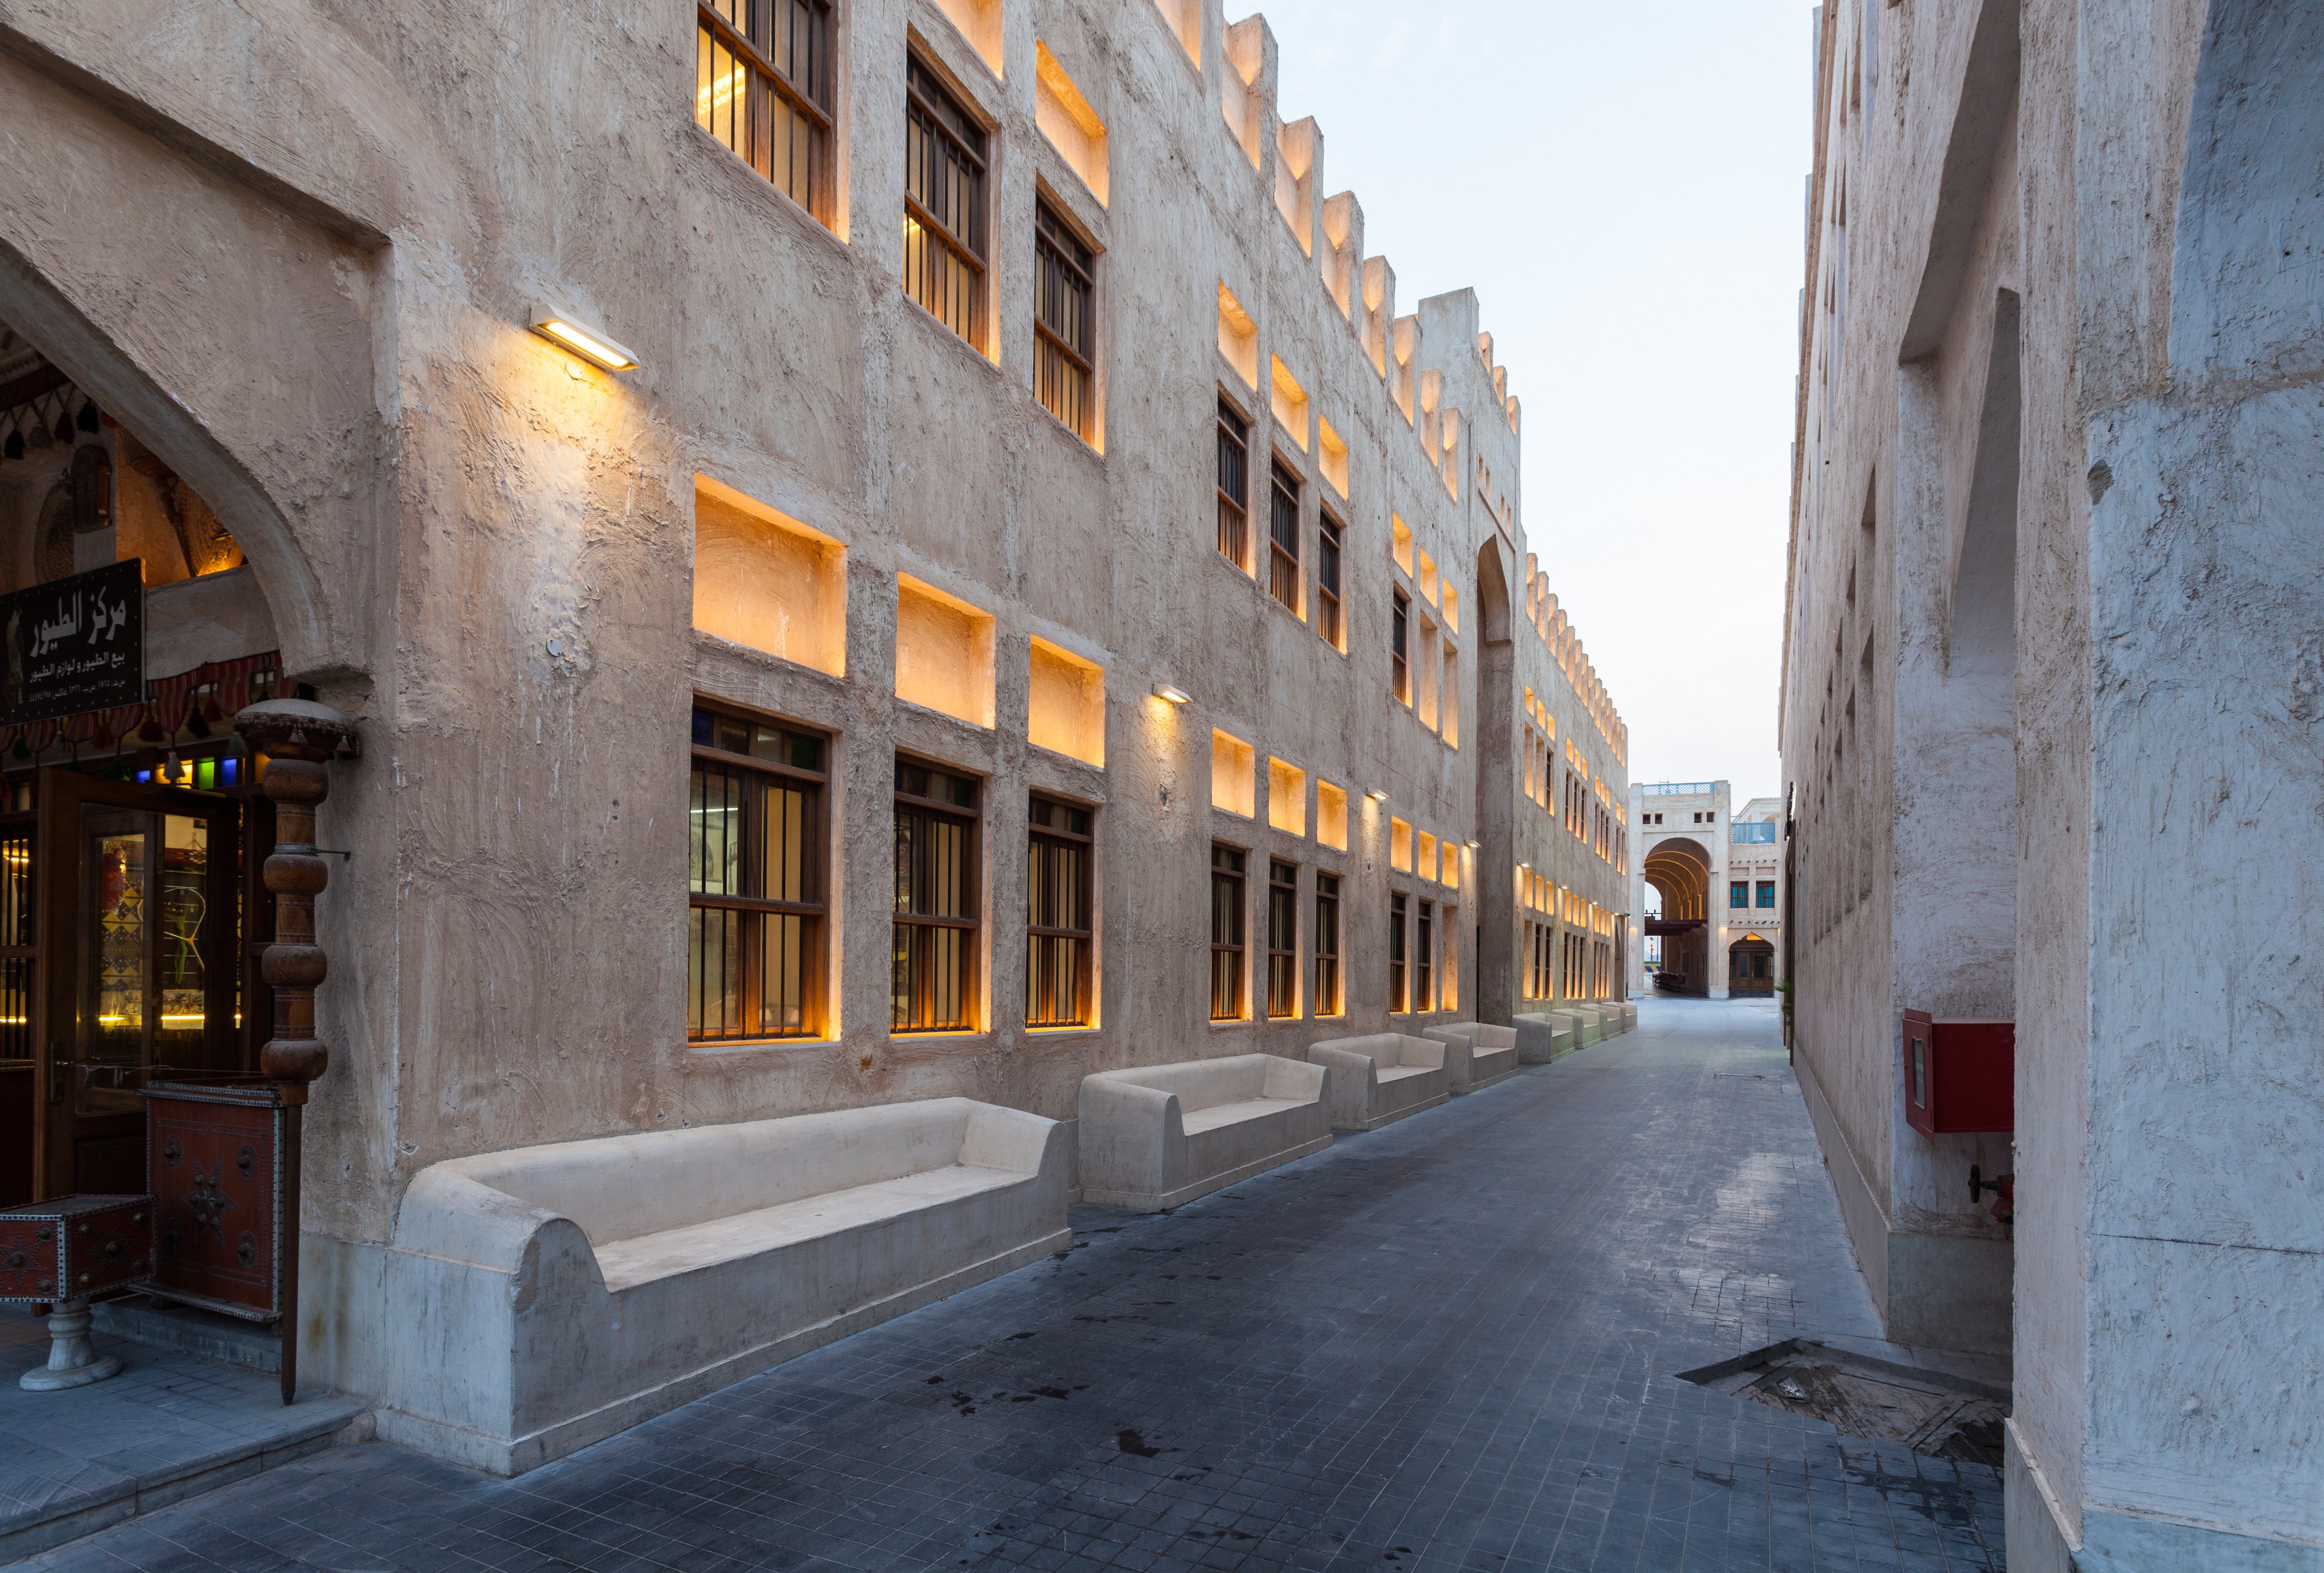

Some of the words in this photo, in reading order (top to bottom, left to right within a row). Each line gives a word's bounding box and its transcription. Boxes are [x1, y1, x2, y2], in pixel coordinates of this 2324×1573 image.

[29, 589, 82, 658] الطيور
[88, 586, 126, 644] مركز
[57, 659, 75, 679] لوازم
[82, 651, 109, 672] الطيور
[111, 652, 125, 669] بيع
[30, 663, 55, 683] الطيور
